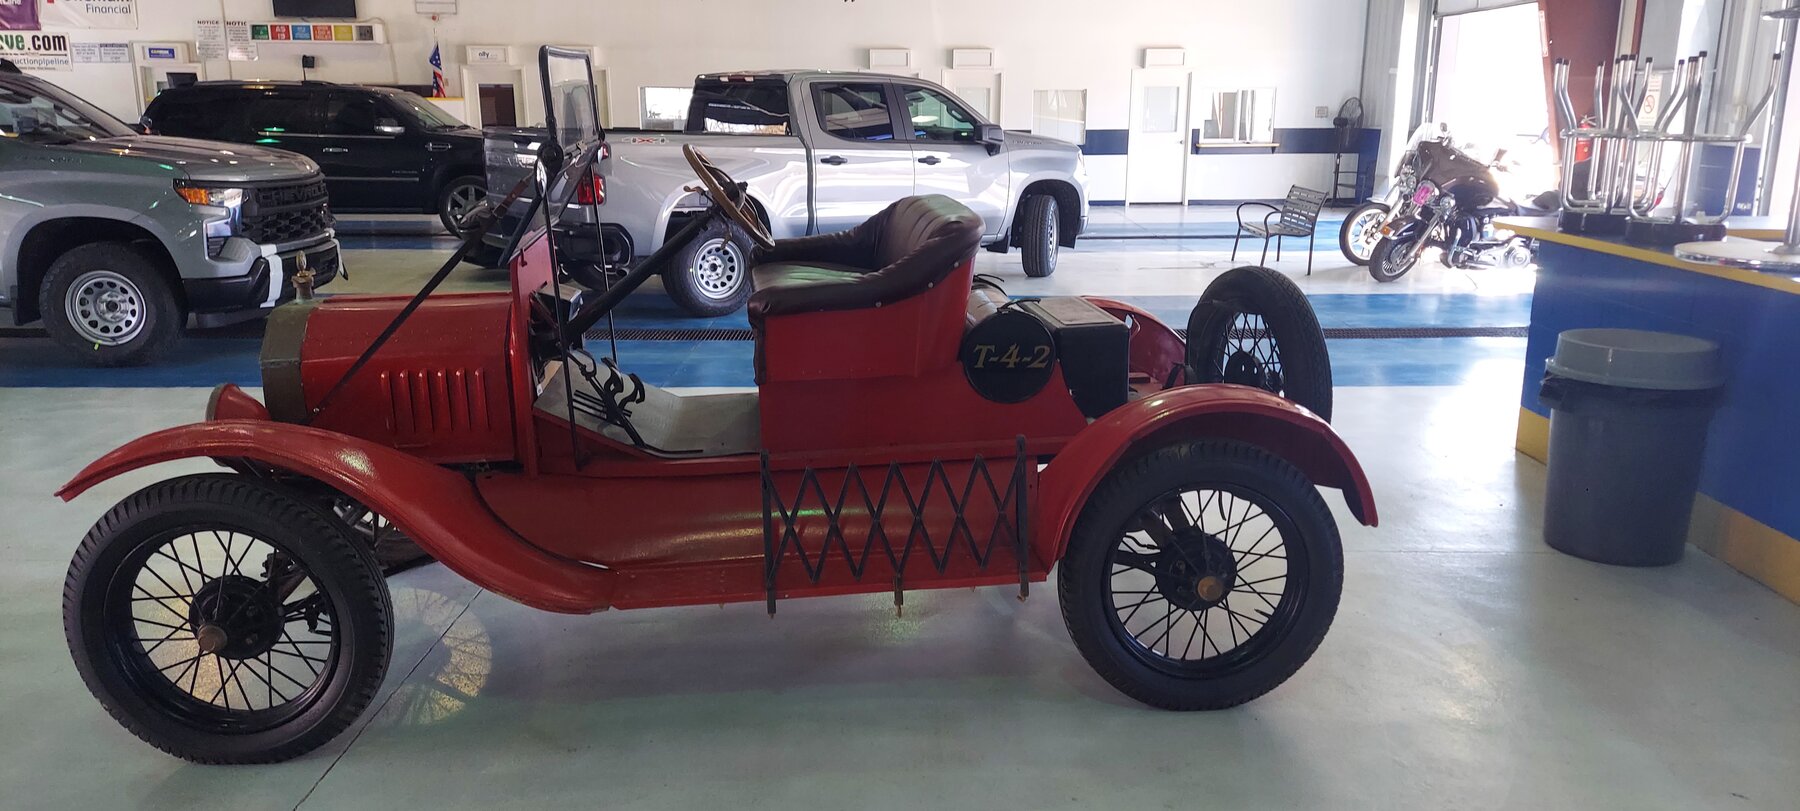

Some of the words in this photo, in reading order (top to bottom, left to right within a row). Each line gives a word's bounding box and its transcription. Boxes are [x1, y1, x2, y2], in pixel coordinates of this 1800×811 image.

[86, 3, 131, 14] Financial
[0, 34, 67, 51] ve.com
[259, 182, 327, 203] CHEVROLE
[973, 342, 1051, 369] T-4-2
